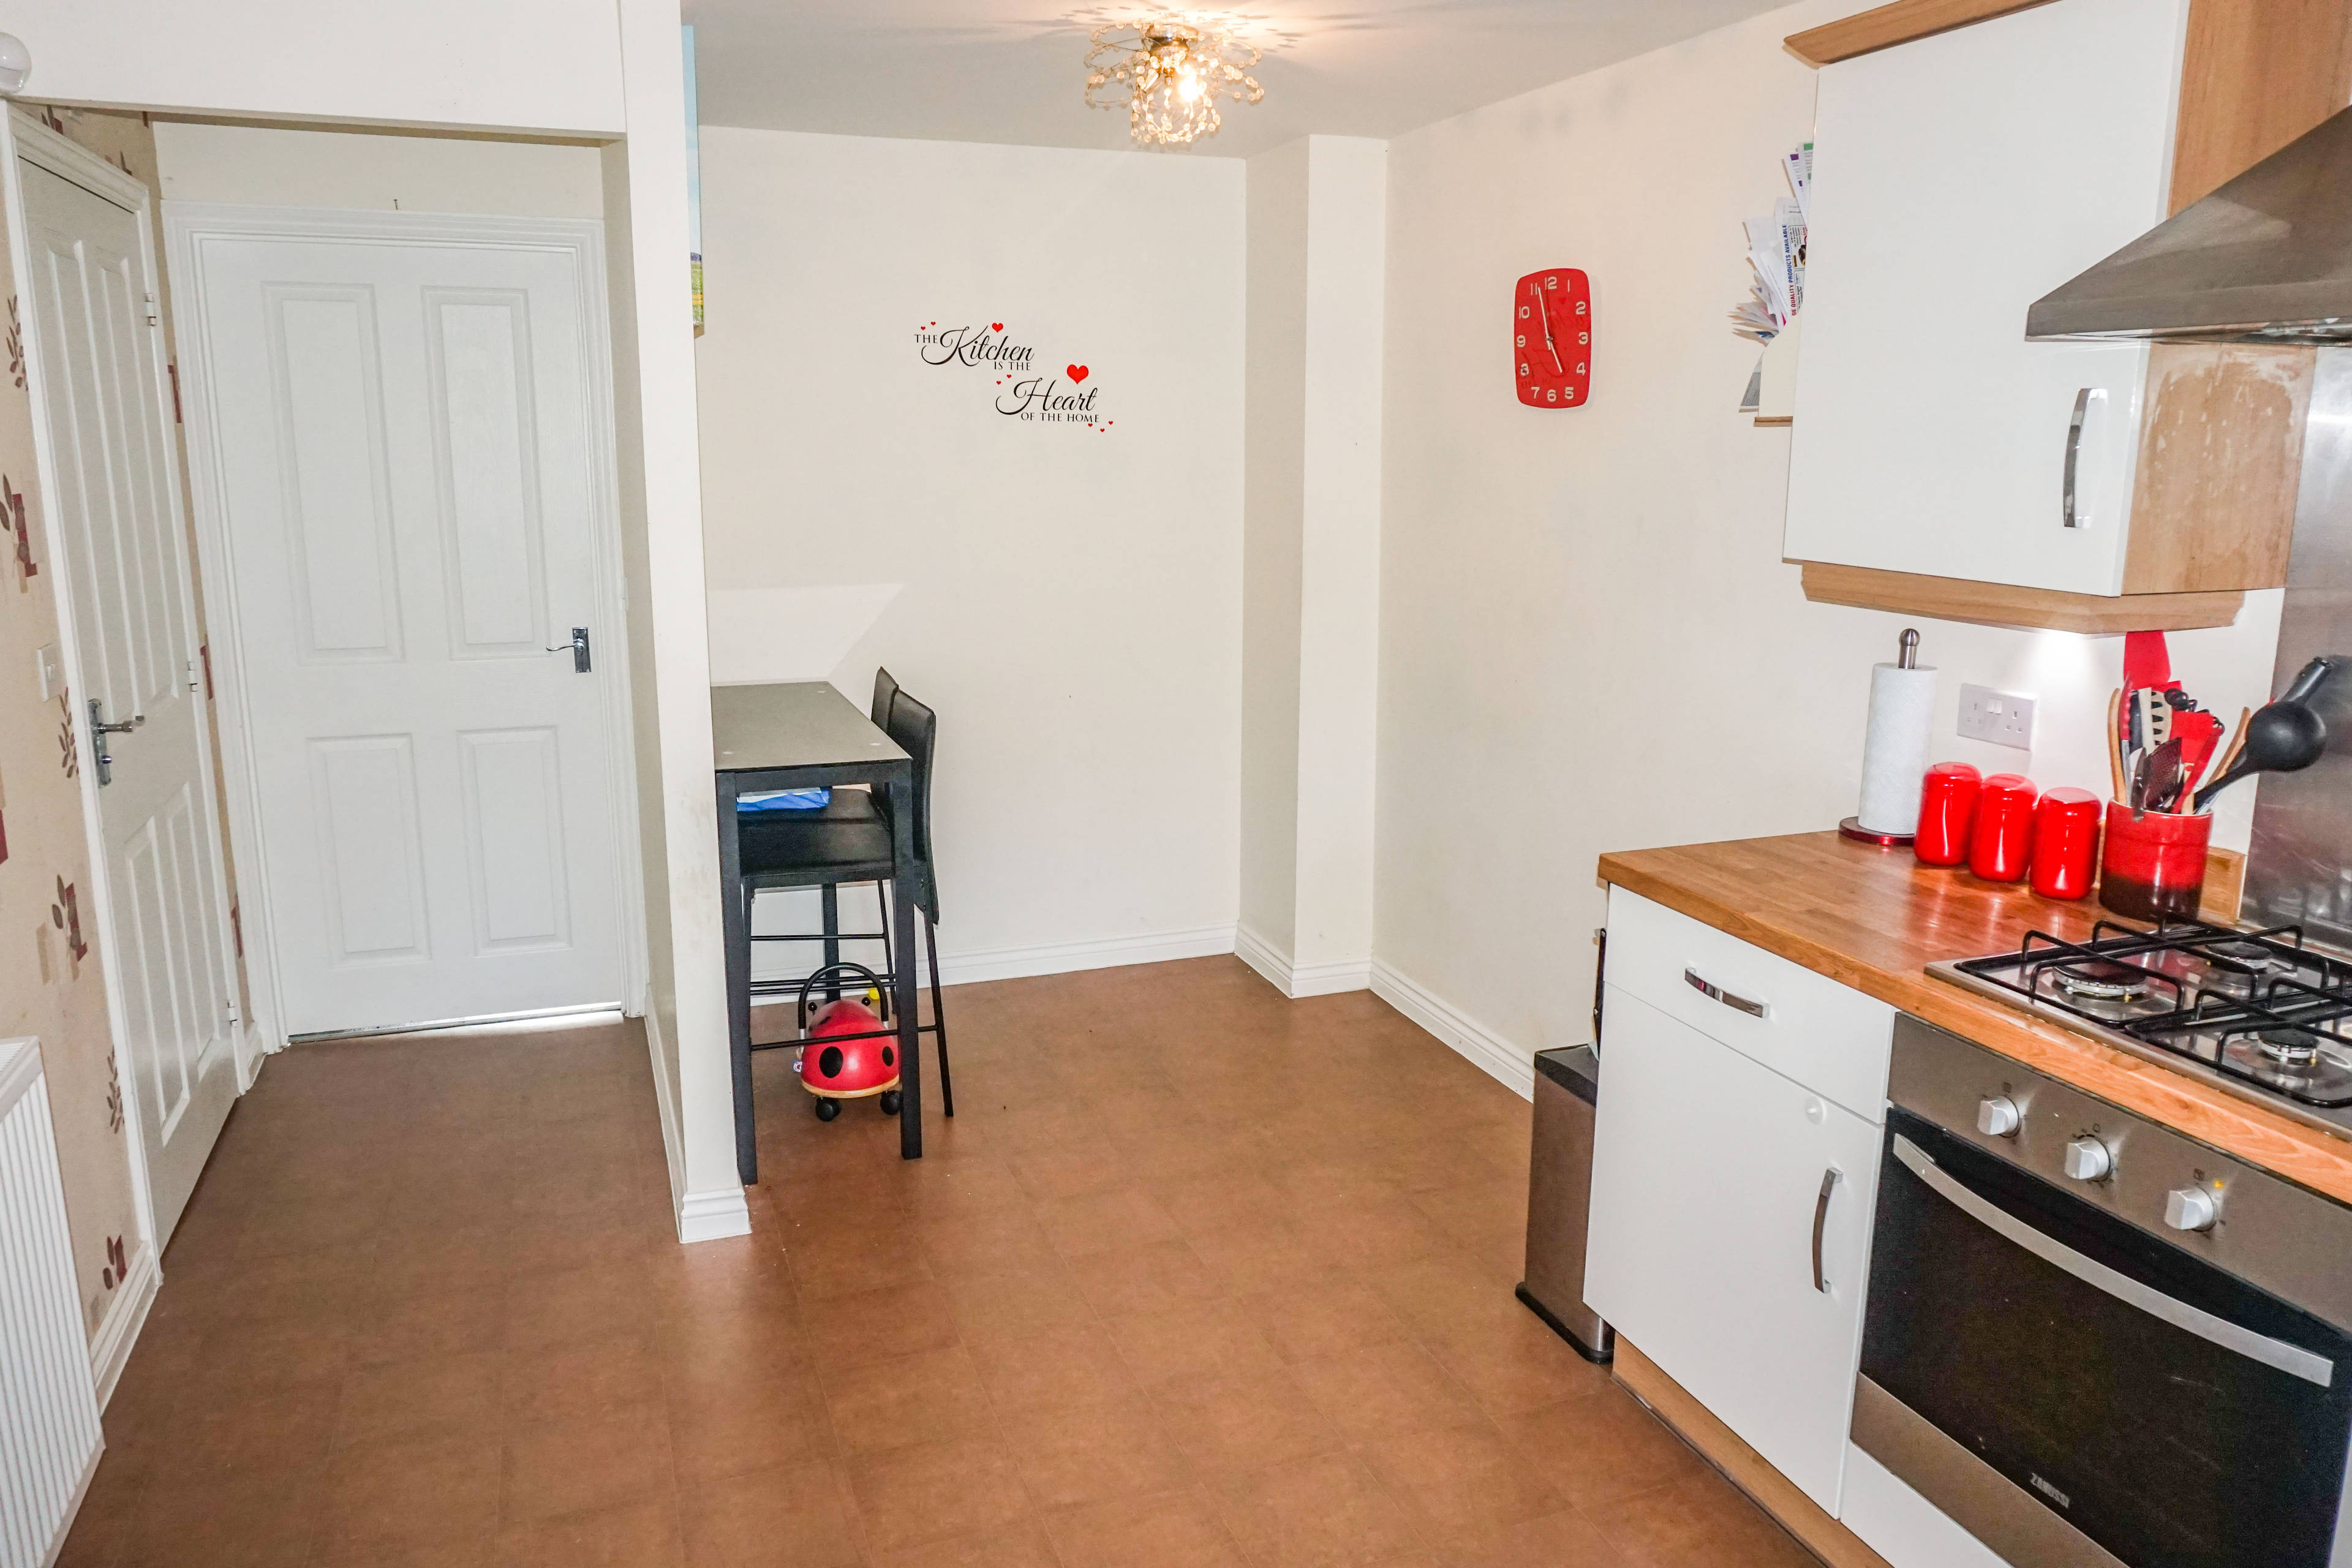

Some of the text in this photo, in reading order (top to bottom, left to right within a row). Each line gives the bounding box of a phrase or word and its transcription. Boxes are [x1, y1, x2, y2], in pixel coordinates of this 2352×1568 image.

[1781, 224, 1790, 253] AVAILABLE
[1785, 254, 1793, 284] PRODUCTS
[1530, 282, 1538, 296] 11
[1544, 276, 1558, 290] 12
[1518, 306, 1530, 319] 10
[1575, 301, 1586, 315] 2
[1517, 334, 1526, 348] 9
[1578, 331, 1589, 345] 3
[914, 325, 1035, 367] THE Kitchen
[993, 361, 1031, 371] IS THE
[1520, 363, 1530, 376] 8
[1576, 362, 1586, 376] 4
[995, 377, 1098, 415] Heart
[1531, 386, 1540, 399] 7
[1547, 389, 1557, 402] 6
[1564, 386, 1574, 400] 5
[1020, 412, 1100, 423] OF THE HOME
